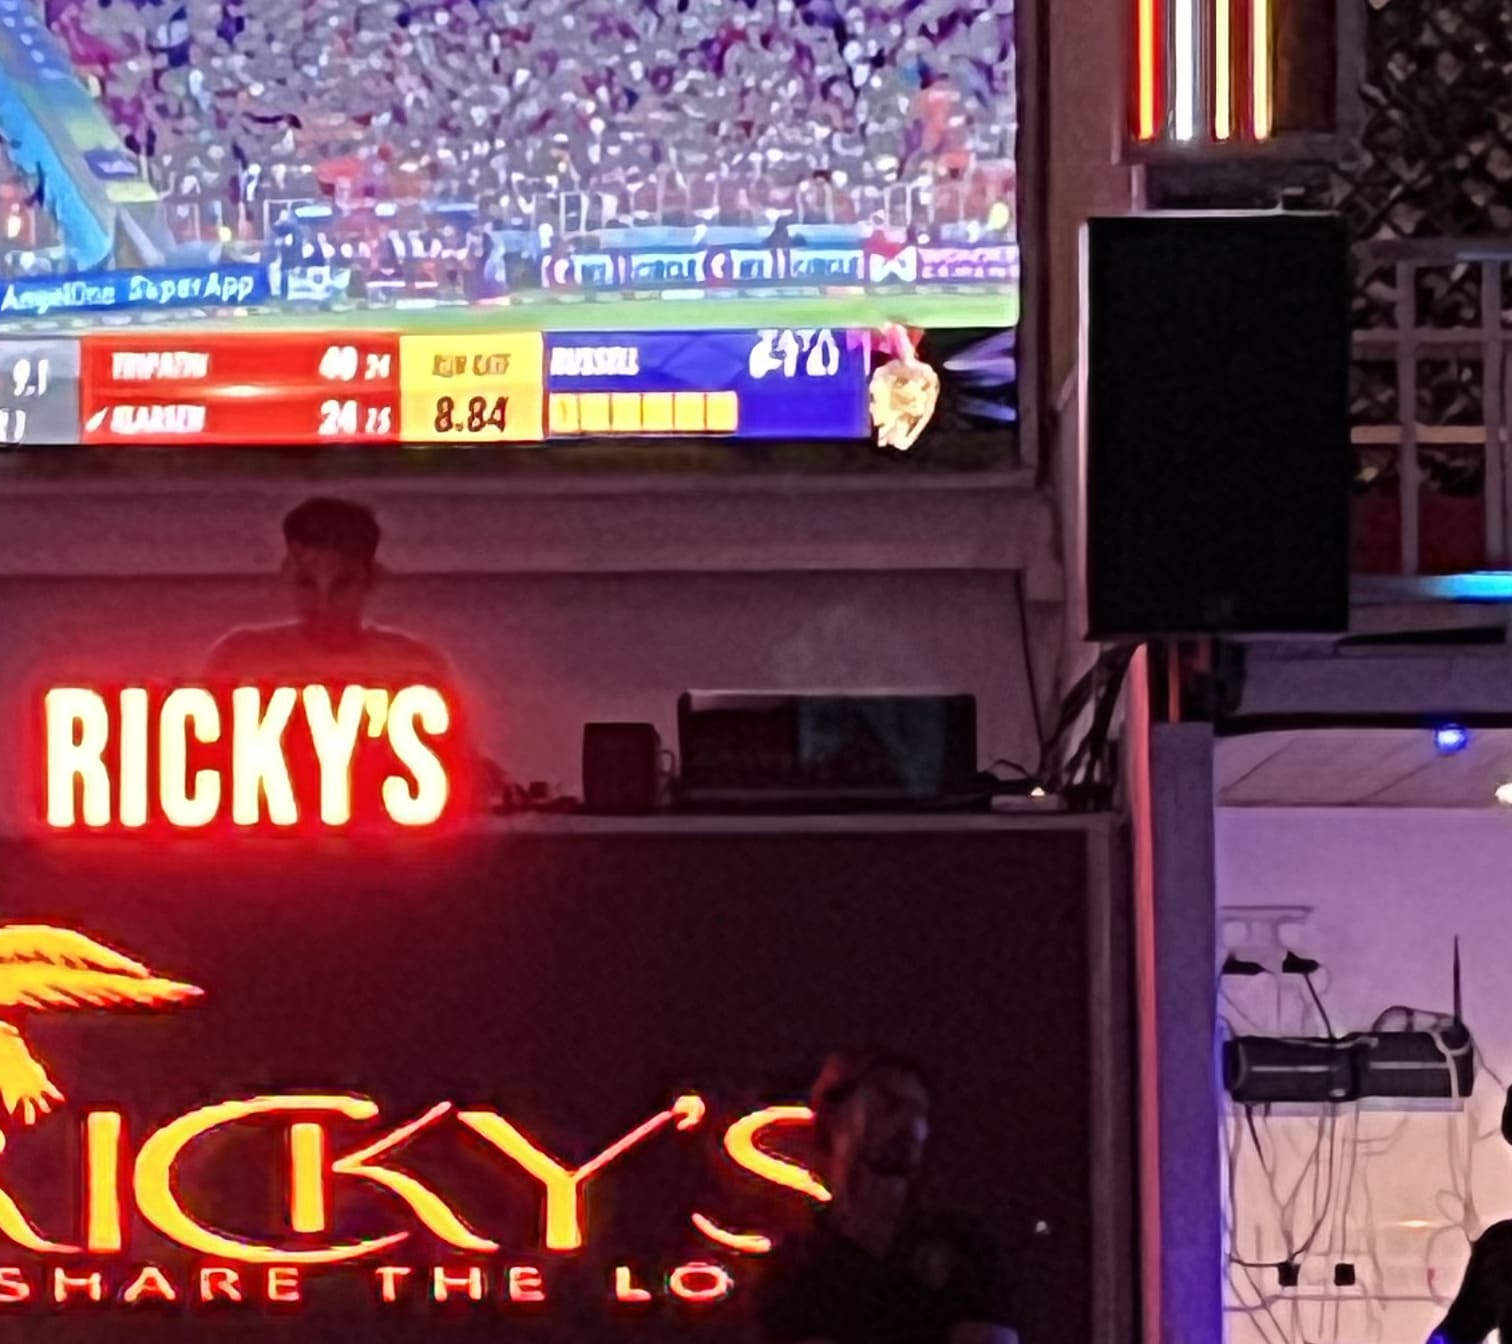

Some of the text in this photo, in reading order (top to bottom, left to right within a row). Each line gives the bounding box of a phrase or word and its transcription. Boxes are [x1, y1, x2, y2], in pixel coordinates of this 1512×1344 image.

[434, 396, 509, 433] 8.84
[45, 684, 450, 828] RICKY'S
[375, 1266, 546, 1303] THE
[613, 1262, 735, 1302] LO
